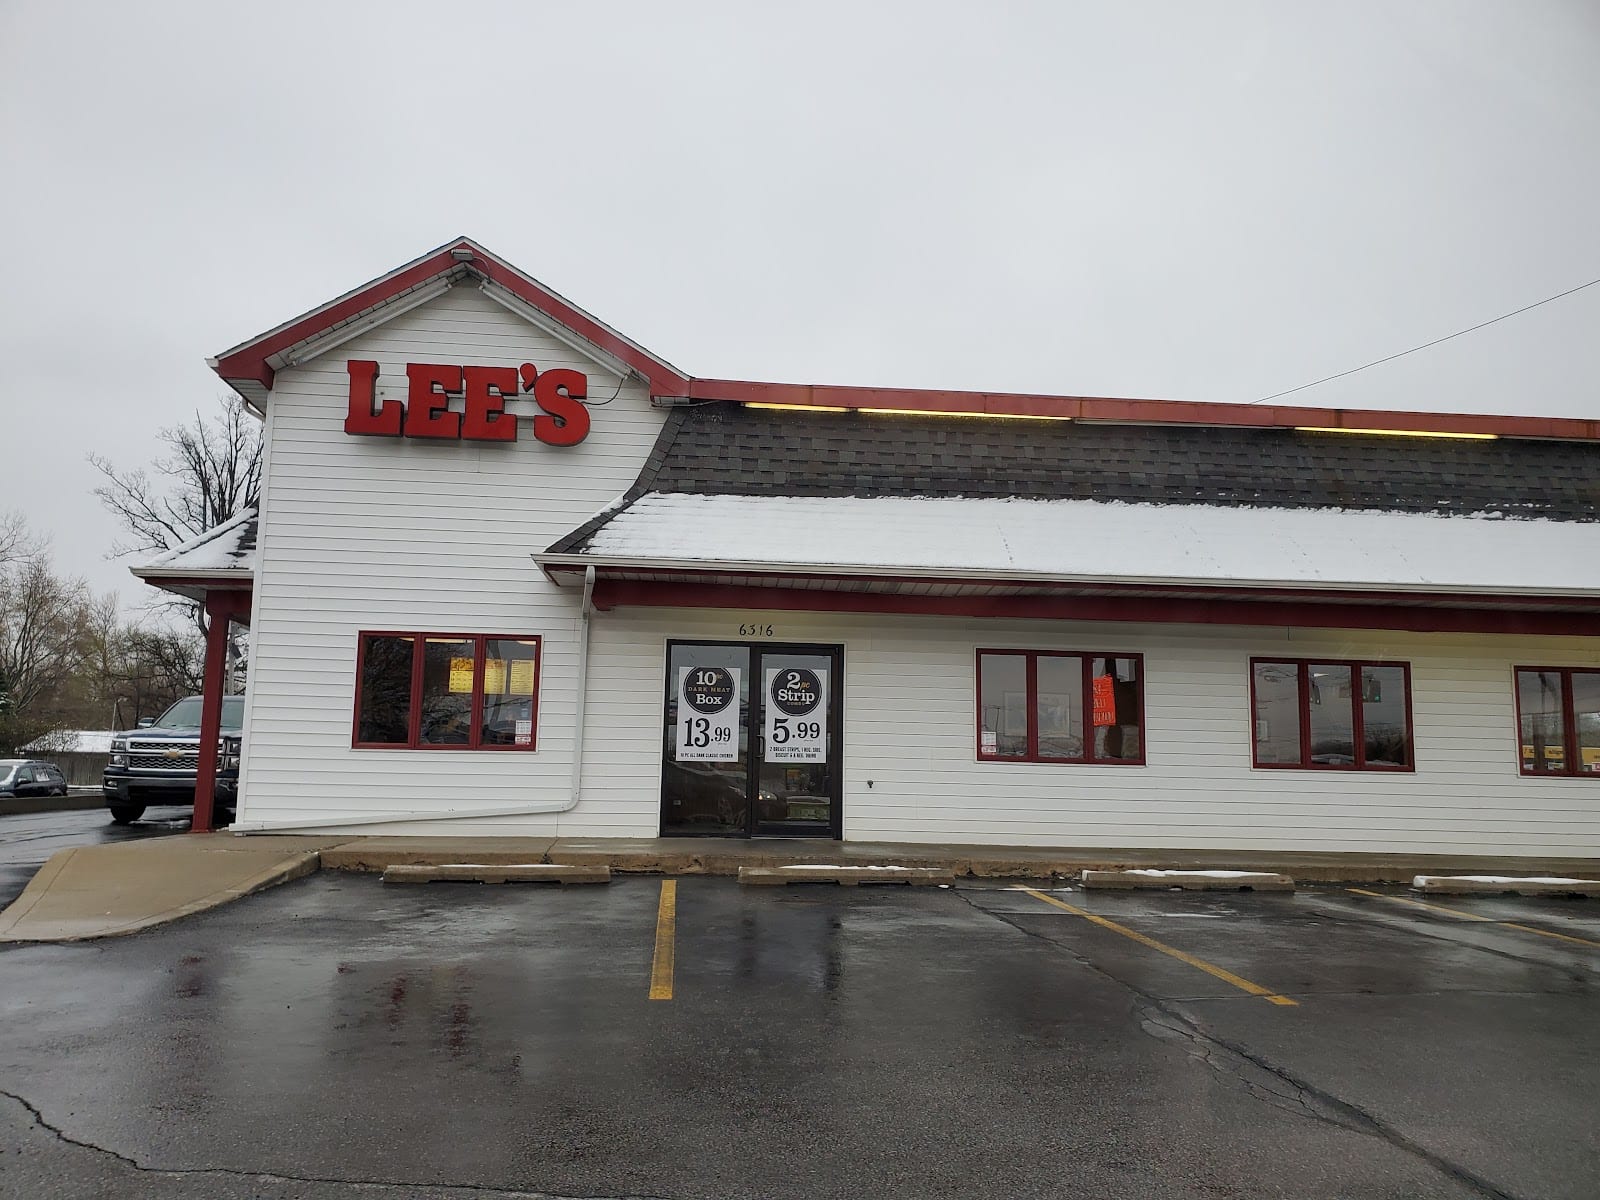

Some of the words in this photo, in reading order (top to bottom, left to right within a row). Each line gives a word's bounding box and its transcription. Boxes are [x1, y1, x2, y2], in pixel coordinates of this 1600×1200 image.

[344, 360, 590, 447] LEE'S
[739, 624, 773, 637] 6316
[696, 670, 717, 686] 10
[786, 672, 801, 690] 2
[695, 693, 722, 705] Box
[777, 688, 815, 705] Strip
[684, 717, 731, 747] 13.99
[772, 717, 820, 744] 5.99
